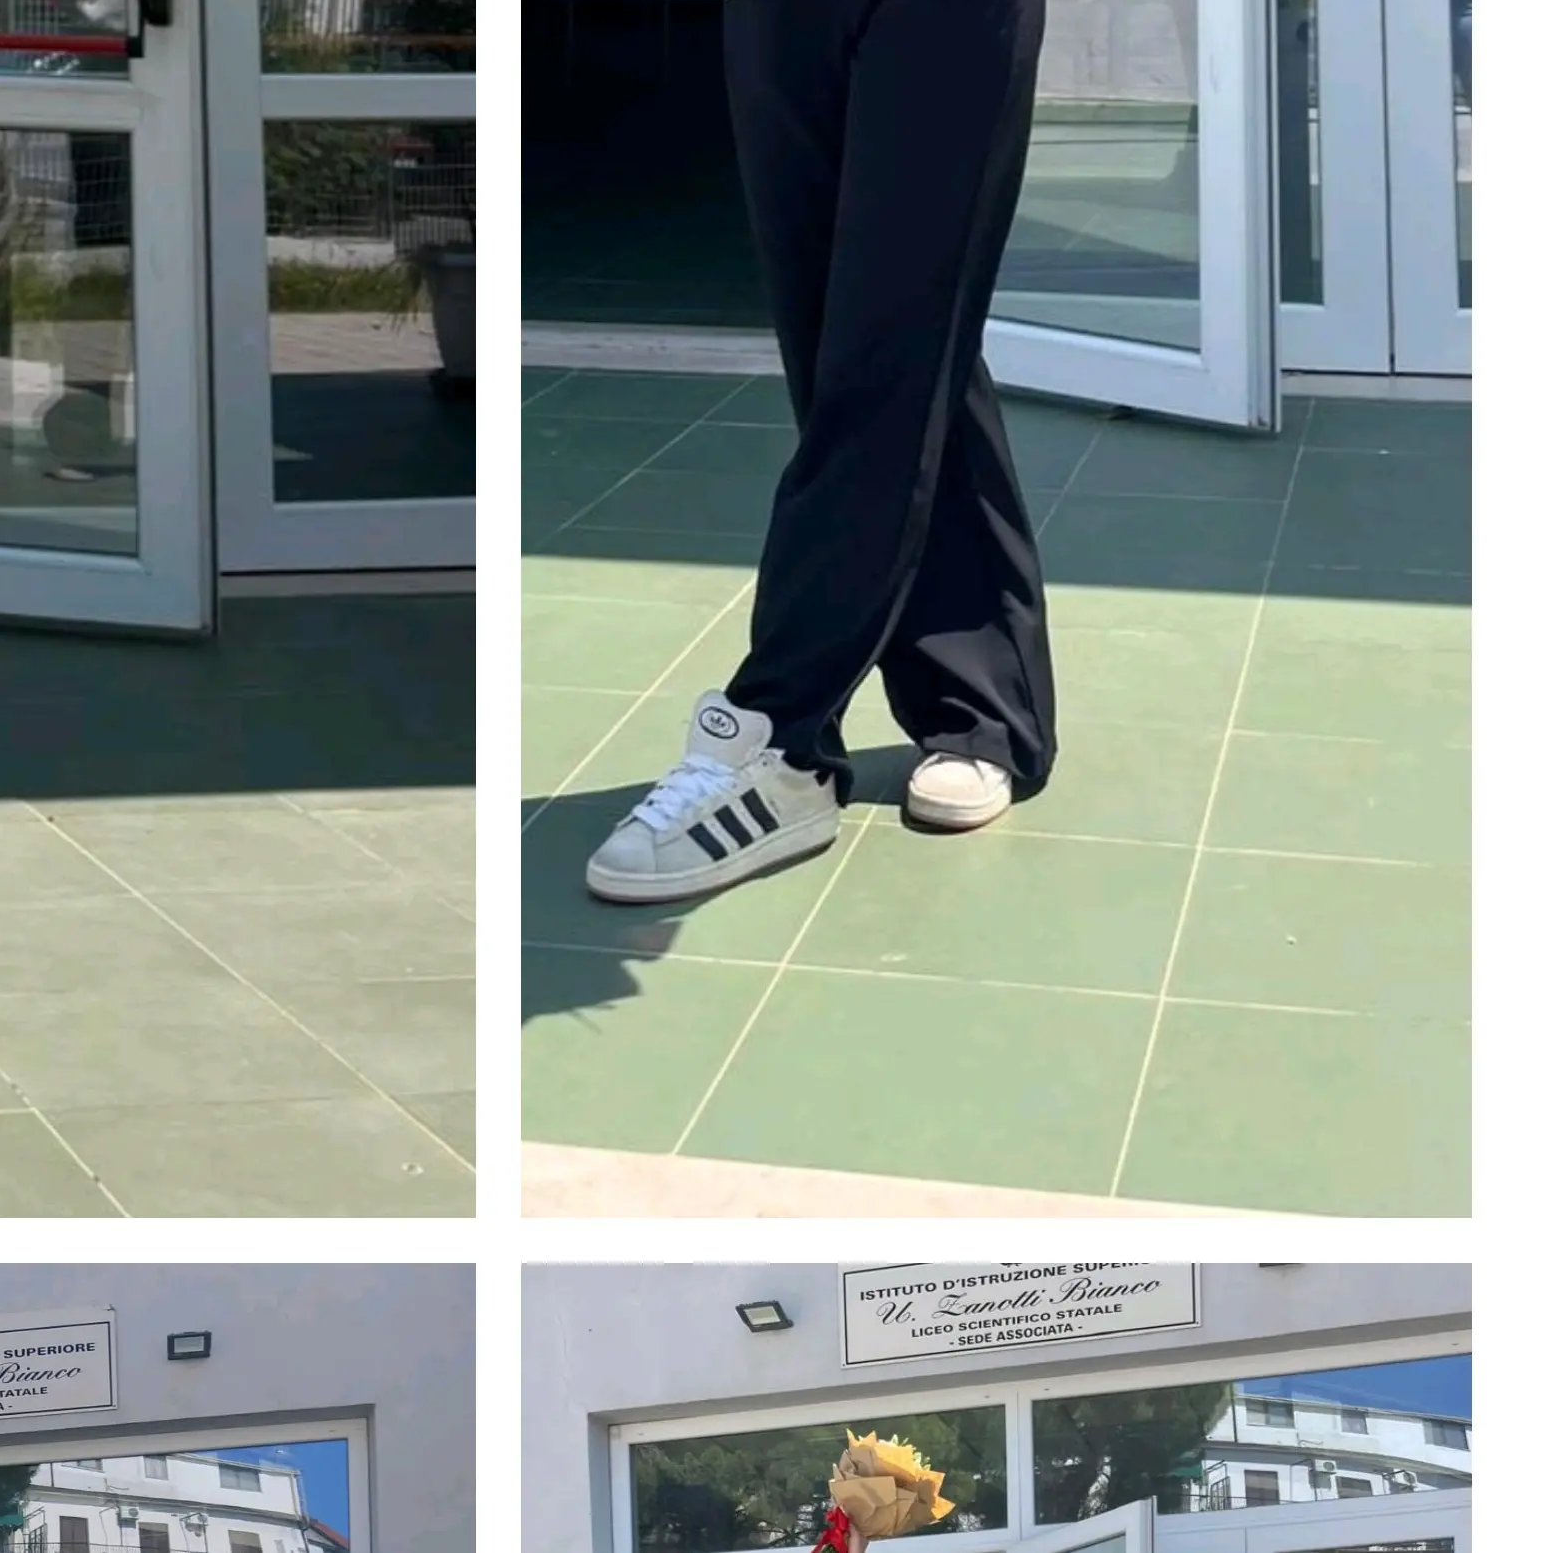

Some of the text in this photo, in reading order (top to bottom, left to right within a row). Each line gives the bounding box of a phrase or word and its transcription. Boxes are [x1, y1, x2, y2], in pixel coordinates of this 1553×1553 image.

[860, 1282, 938, 1302] ISTITUTO
[943, 1265, 1067, 1291] D'ISTRUZIONE
[875, 1277, 1159, 1326] U. Zanotti Bianco
[911, 1303, 1123, 1338] LICEO SCIENTIFICO STATALE
[957, 1332, 992, 1347] SEDE
[996, 1322, 1074, 1342] ASSOCIATA
[3, 1342, 96, 1359] SUPERIORE
